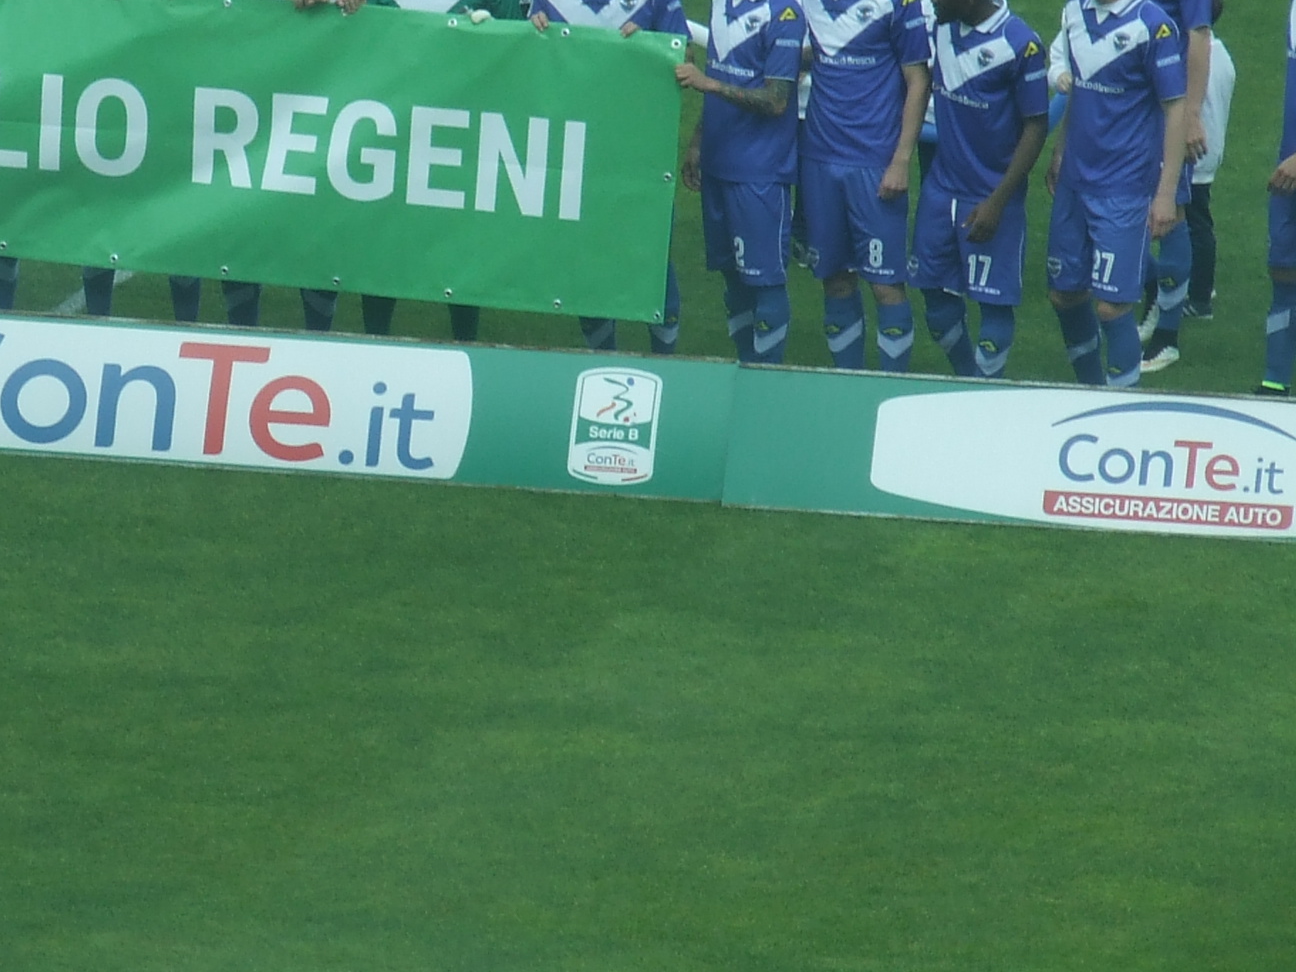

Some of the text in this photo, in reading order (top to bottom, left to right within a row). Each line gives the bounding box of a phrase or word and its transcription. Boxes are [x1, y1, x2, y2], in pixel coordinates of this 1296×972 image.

[191, 86, 586, 221] REGENI
[868, 238, 884, 268] 8
[967, 254, 992, 287] 17
[589, 425, 639, 441] Serie B
[1058, 433, 1284, 495] ConTe.it
[1053, 495, 1282, 526] ASSICURAZIONE AUTO
